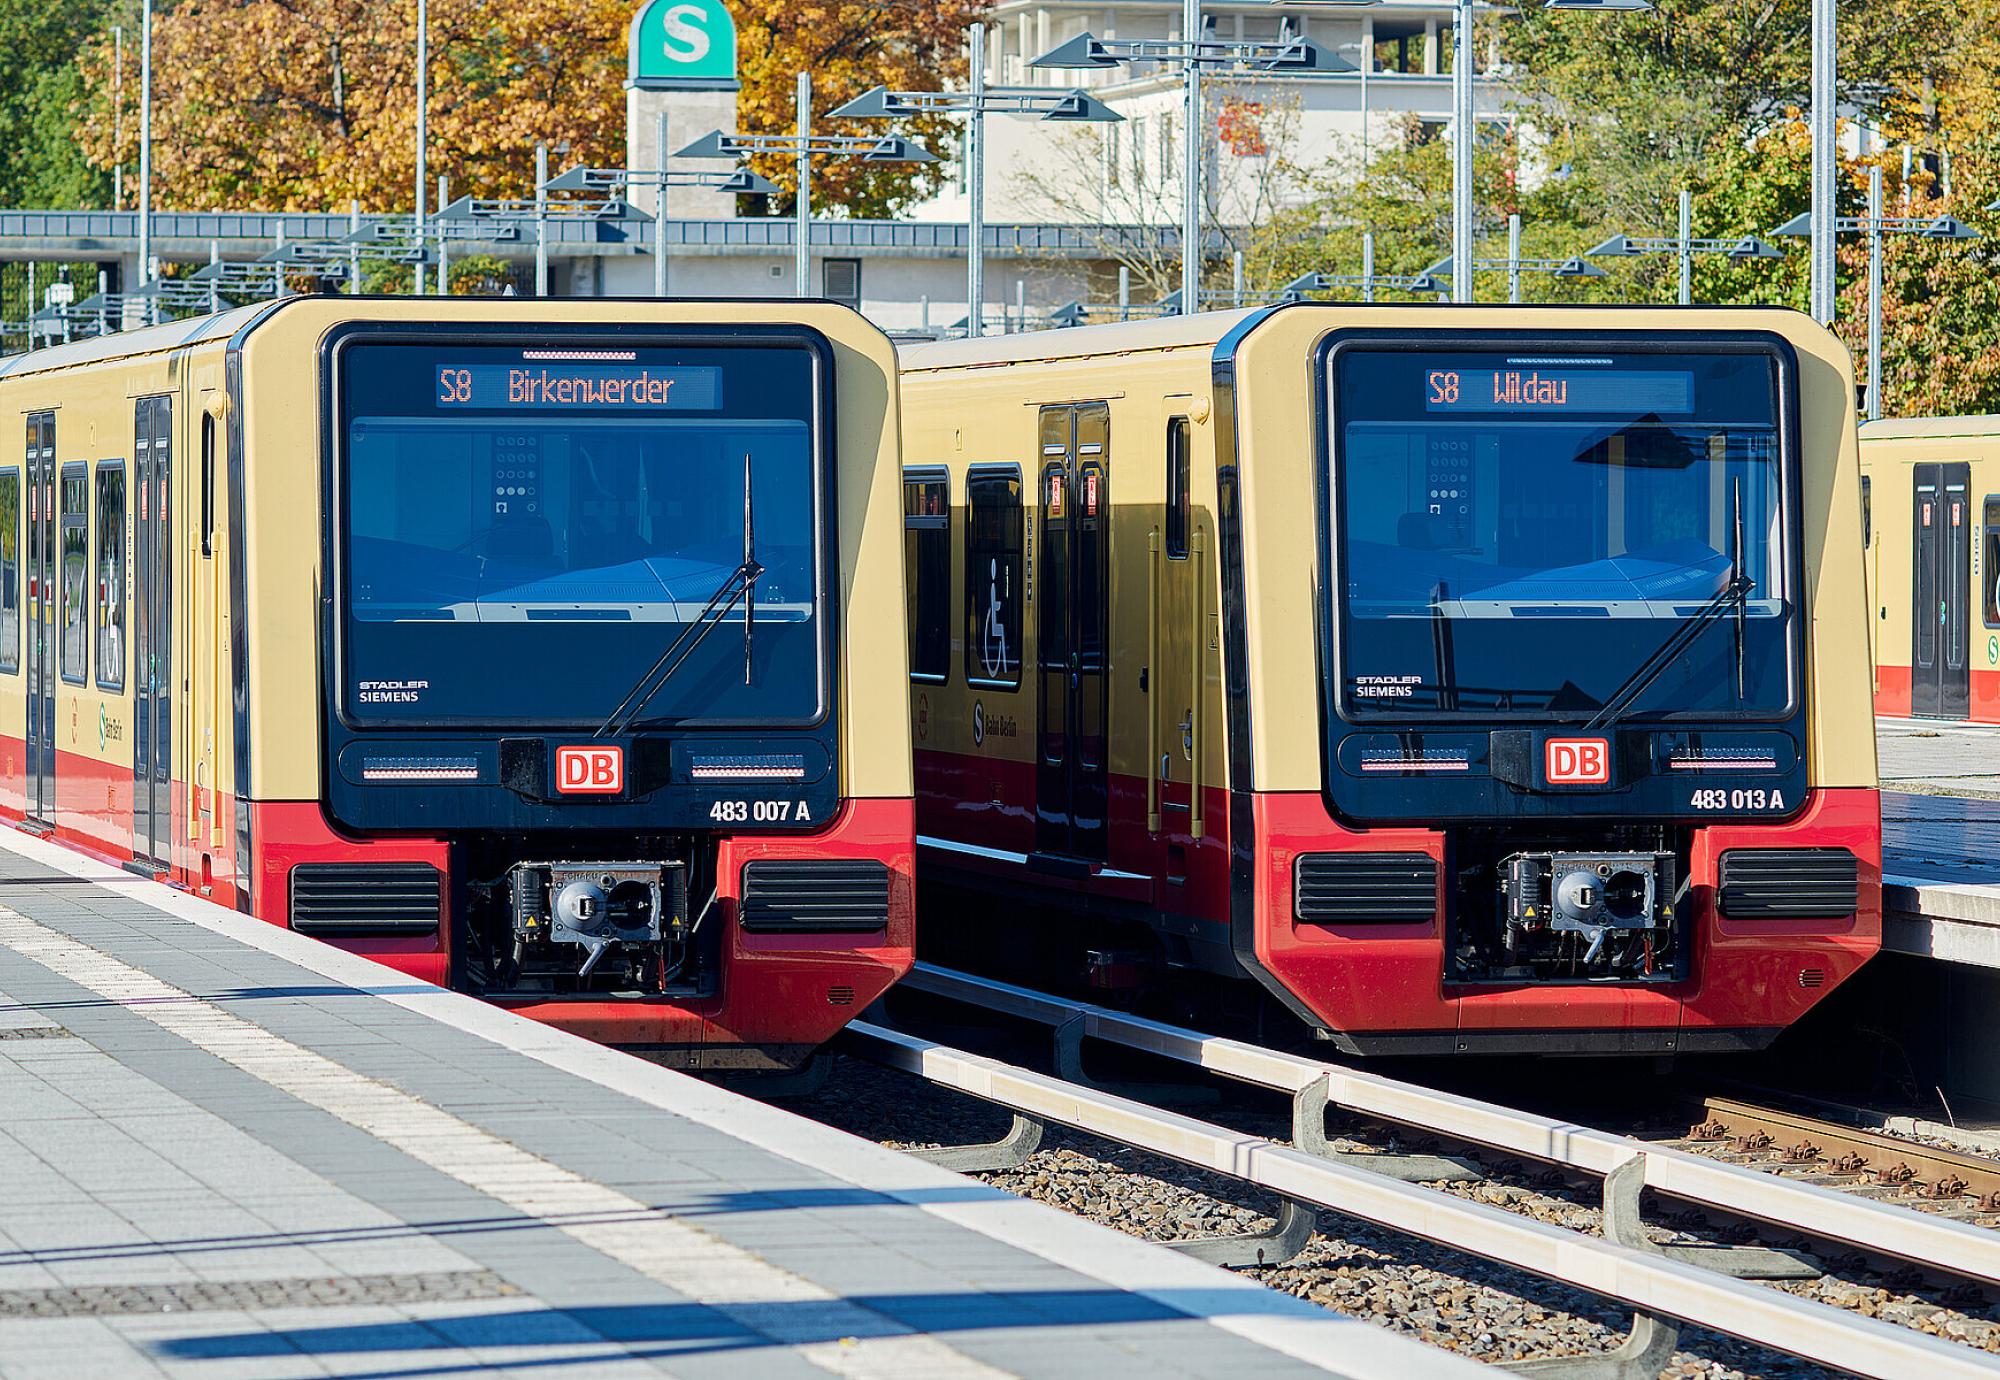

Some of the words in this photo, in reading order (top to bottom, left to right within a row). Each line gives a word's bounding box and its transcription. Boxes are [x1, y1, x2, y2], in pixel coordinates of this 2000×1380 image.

[662, 4, 710, 63] S
[440, 369, 472, 402] S8
[509, 369, 675, 404] Birkenwerder
[1429, 372, 1459, 404] S8
[1493, 372, 1567, 404] Wildau
[359, 680, 429, 690] STADLER
[1356, 675, 1422, 684] STADLER
[359, 691, 419, 703] SIEMENS
[1356, 686, 1413, 697] SIEMENS
[565, 754, 615, 785] DB
[1554, 745, 1601, 776] DB
[1690, 789, 1727, 809] 483
[1731, 789, 1766, 809] 013
[1769, 789, 1785, 809] A
[709, 800, 748, 821] 483
[753, 800, 791, 821] 007
[794, 800, 811, 820] A
